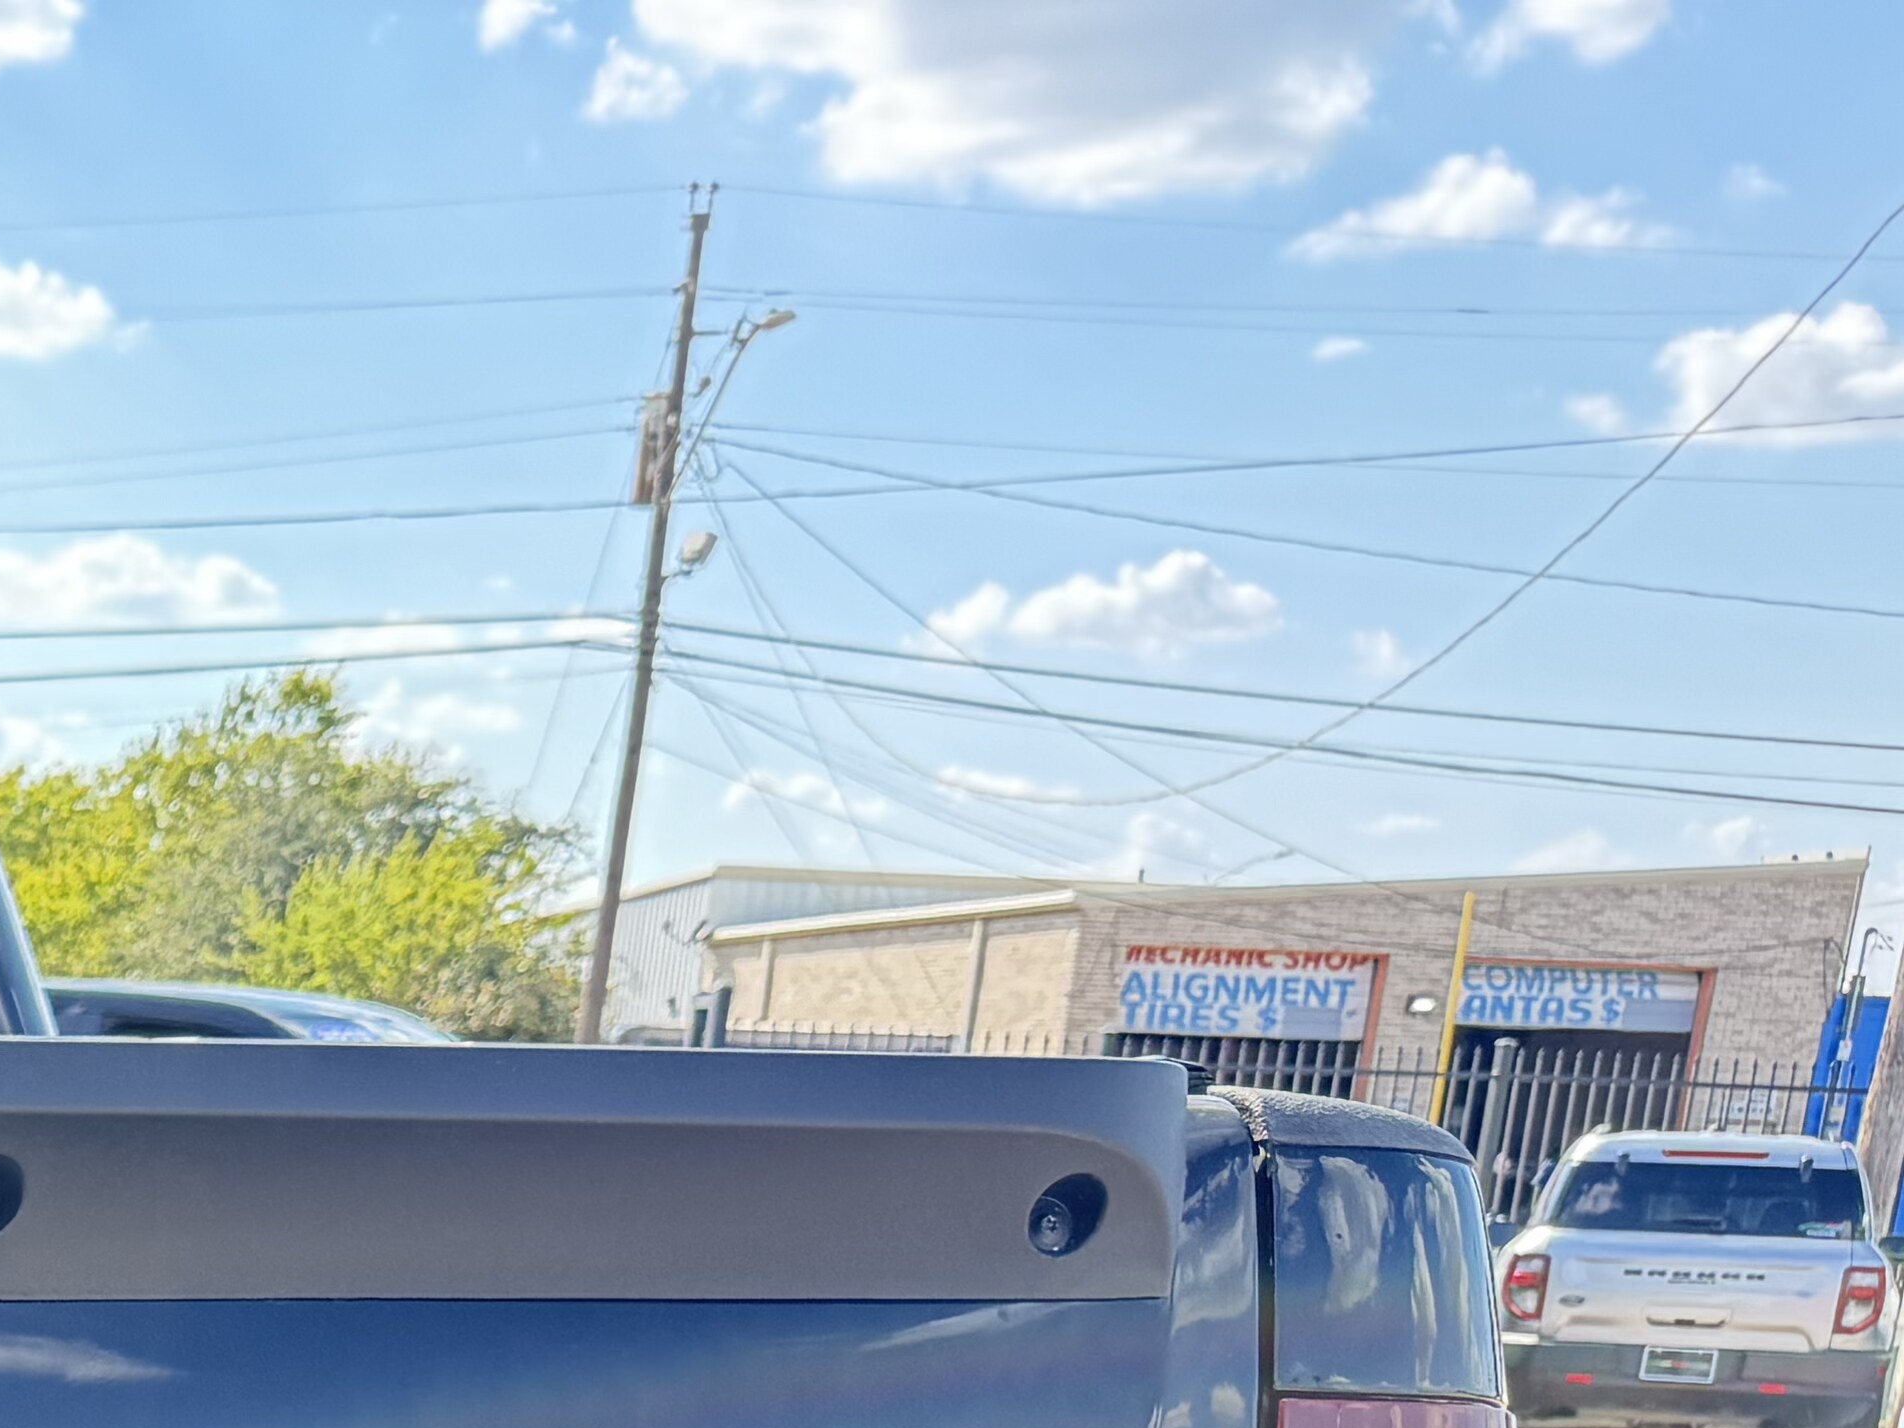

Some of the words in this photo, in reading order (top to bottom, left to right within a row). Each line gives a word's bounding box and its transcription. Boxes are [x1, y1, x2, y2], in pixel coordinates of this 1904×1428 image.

[1120, 969, 1356, 1008] ALIGNMENT
[1463, 965, 1660, 1000] COMPUTER
[1124, 1002, 1240, 1033] TIRES
